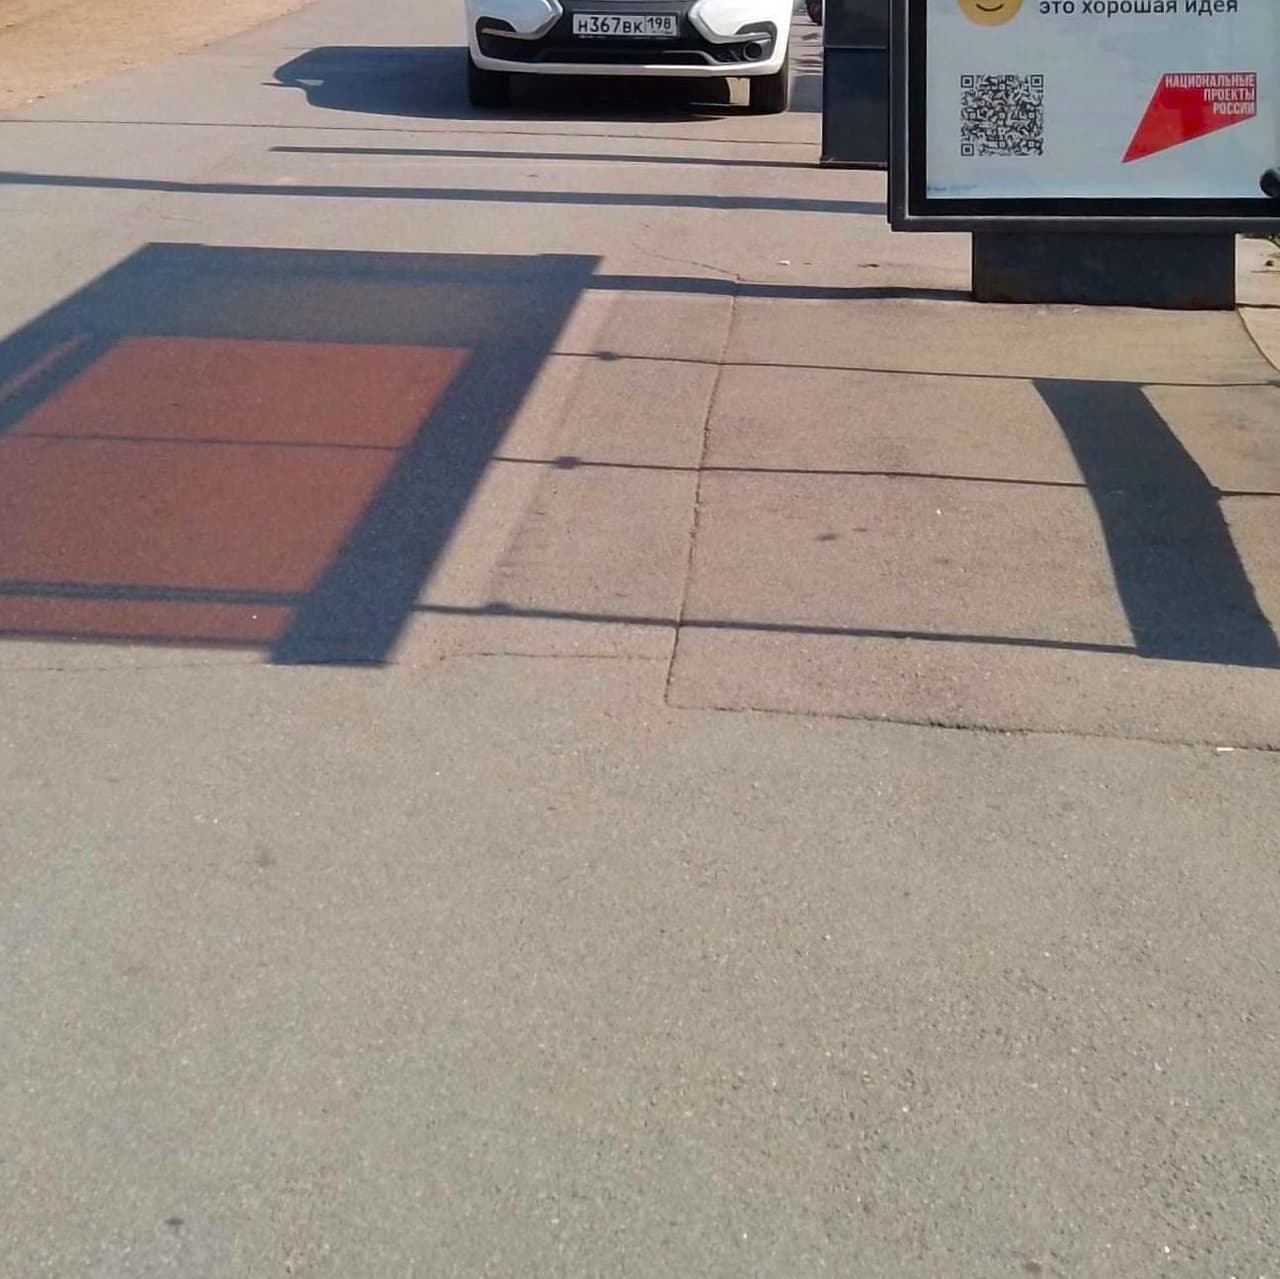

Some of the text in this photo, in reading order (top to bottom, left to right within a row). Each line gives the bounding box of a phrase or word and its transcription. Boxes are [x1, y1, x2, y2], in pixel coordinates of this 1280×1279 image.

[1039, 0, 1075, 15] это
[647, 16, 672, 30] 198
[1165, 73, 1255, 89] НАЦИОНАЛЬНЫЕ
[1203, 87, 1255, 102] ПРОЕКТЫ
[1212, 101, 1256, 116] РОССИИ
